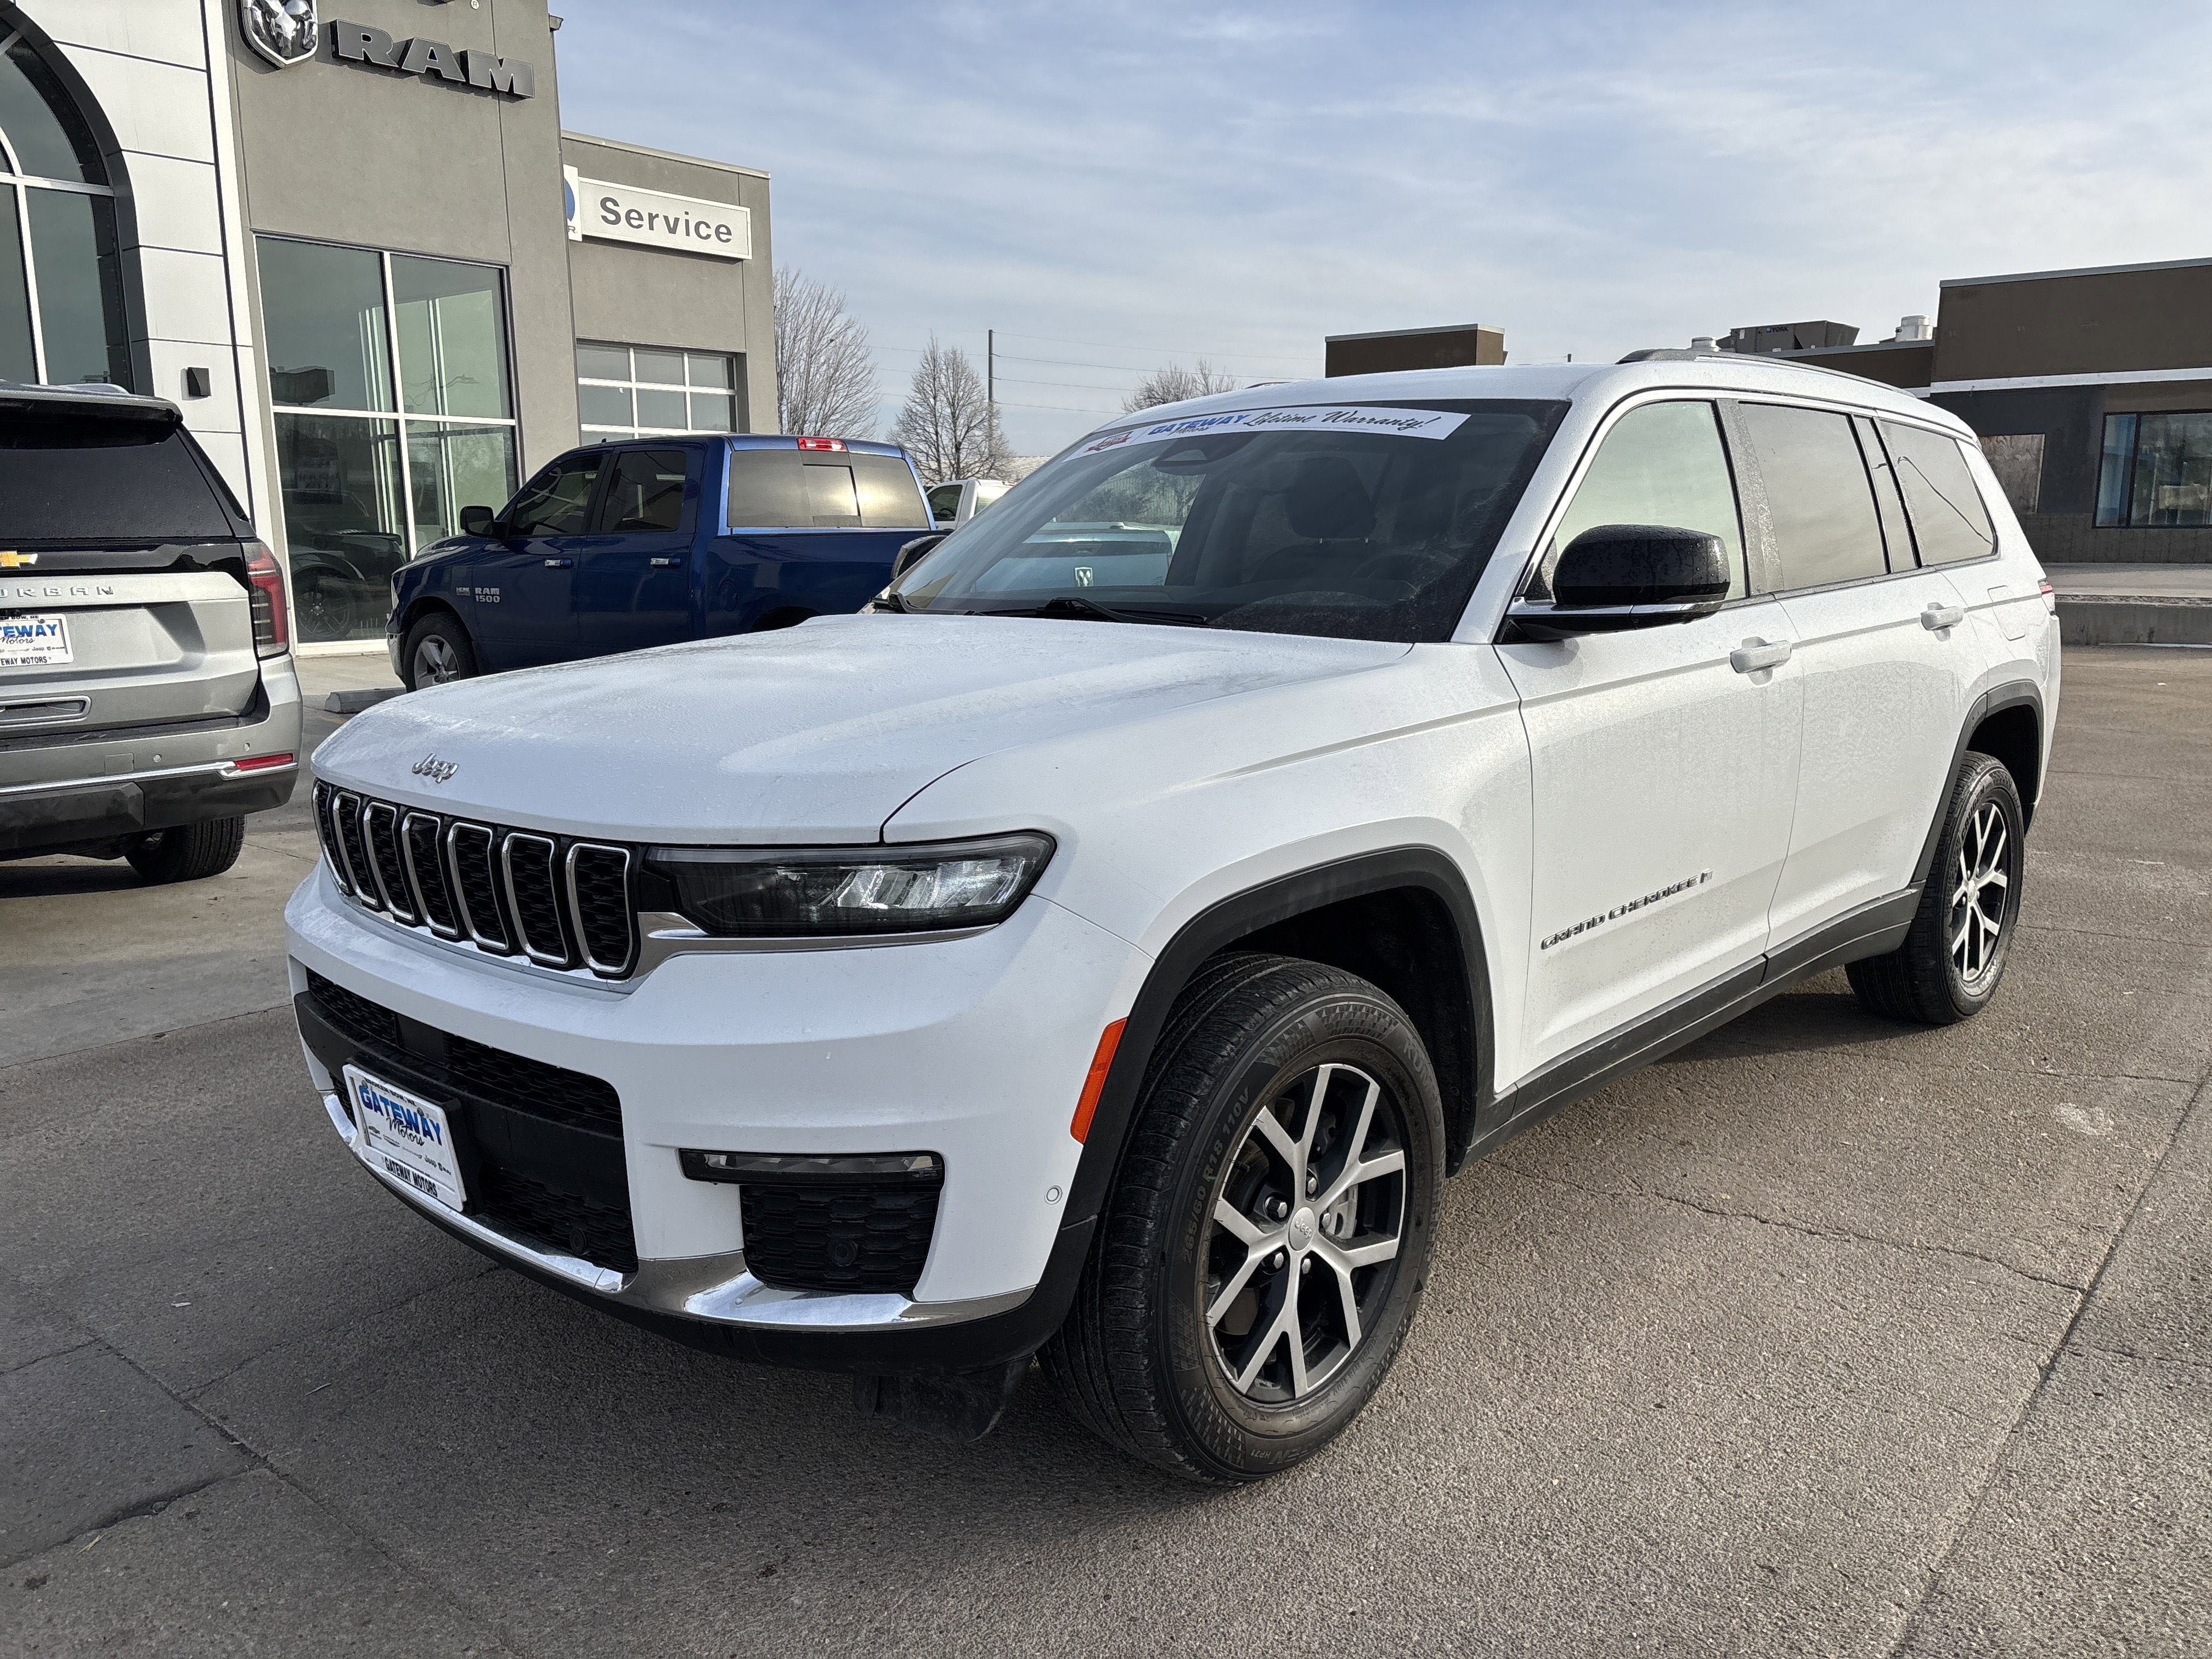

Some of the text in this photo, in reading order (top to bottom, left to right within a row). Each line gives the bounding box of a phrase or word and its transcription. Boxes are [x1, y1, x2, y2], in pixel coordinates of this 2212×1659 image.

[332, 19, 536, 99] RAM
[600, 196, 732, 242] Service
[1148, 410, 1441, 435] GATEWAY Lifetime Warranty!
[475, 587, 500, 595] RAM
[475, 595, 500, 603] 1500
[20, 656, 47, 664] MOTORS
[411, 753, 459, 784] Jeep
[1541, 913, 1606, 950] GRAND
[1608, 874, 1699, 920] CHEROKEE
[359, 1084, 443, 1146] GATEWAY
[386, 1118, 425, 1147] Motors
[385, 1156, 411, 1183] GATEWAY
[411, 1171, 438, 1198] MOTORS
[1183, 1185, 1206, 1264] 265/60
[1202, 1139, 1223, 1182] R18
[1222, 1087, 1249, 1135] 110V
[1295, 1218, 1313, 1240] Jeep
